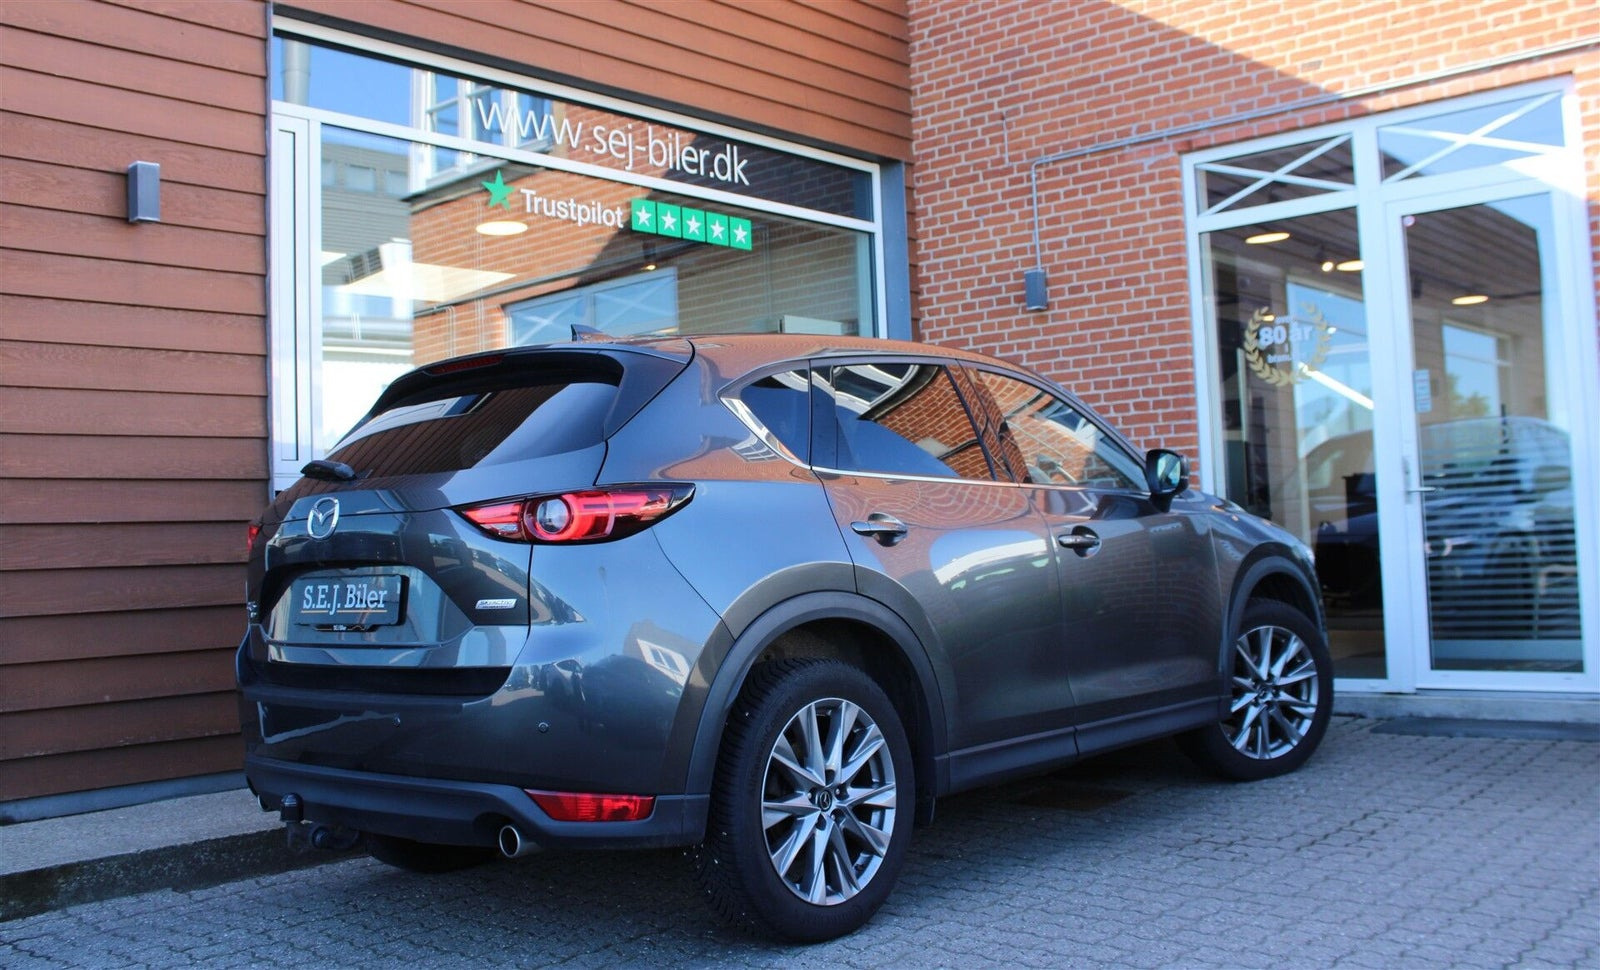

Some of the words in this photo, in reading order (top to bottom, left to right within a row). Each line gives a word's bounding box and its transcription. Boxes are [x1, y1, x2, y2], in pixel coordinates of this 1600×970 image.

[477, 98, 750, 185] www.sej-biler.dk
[520, 188, 624, 228] Trustpilot
[1259, 325, 1287, 347] 80
[303, 585, 341, 615] S.E.J.
[344, 583, 388, 608] Biler
